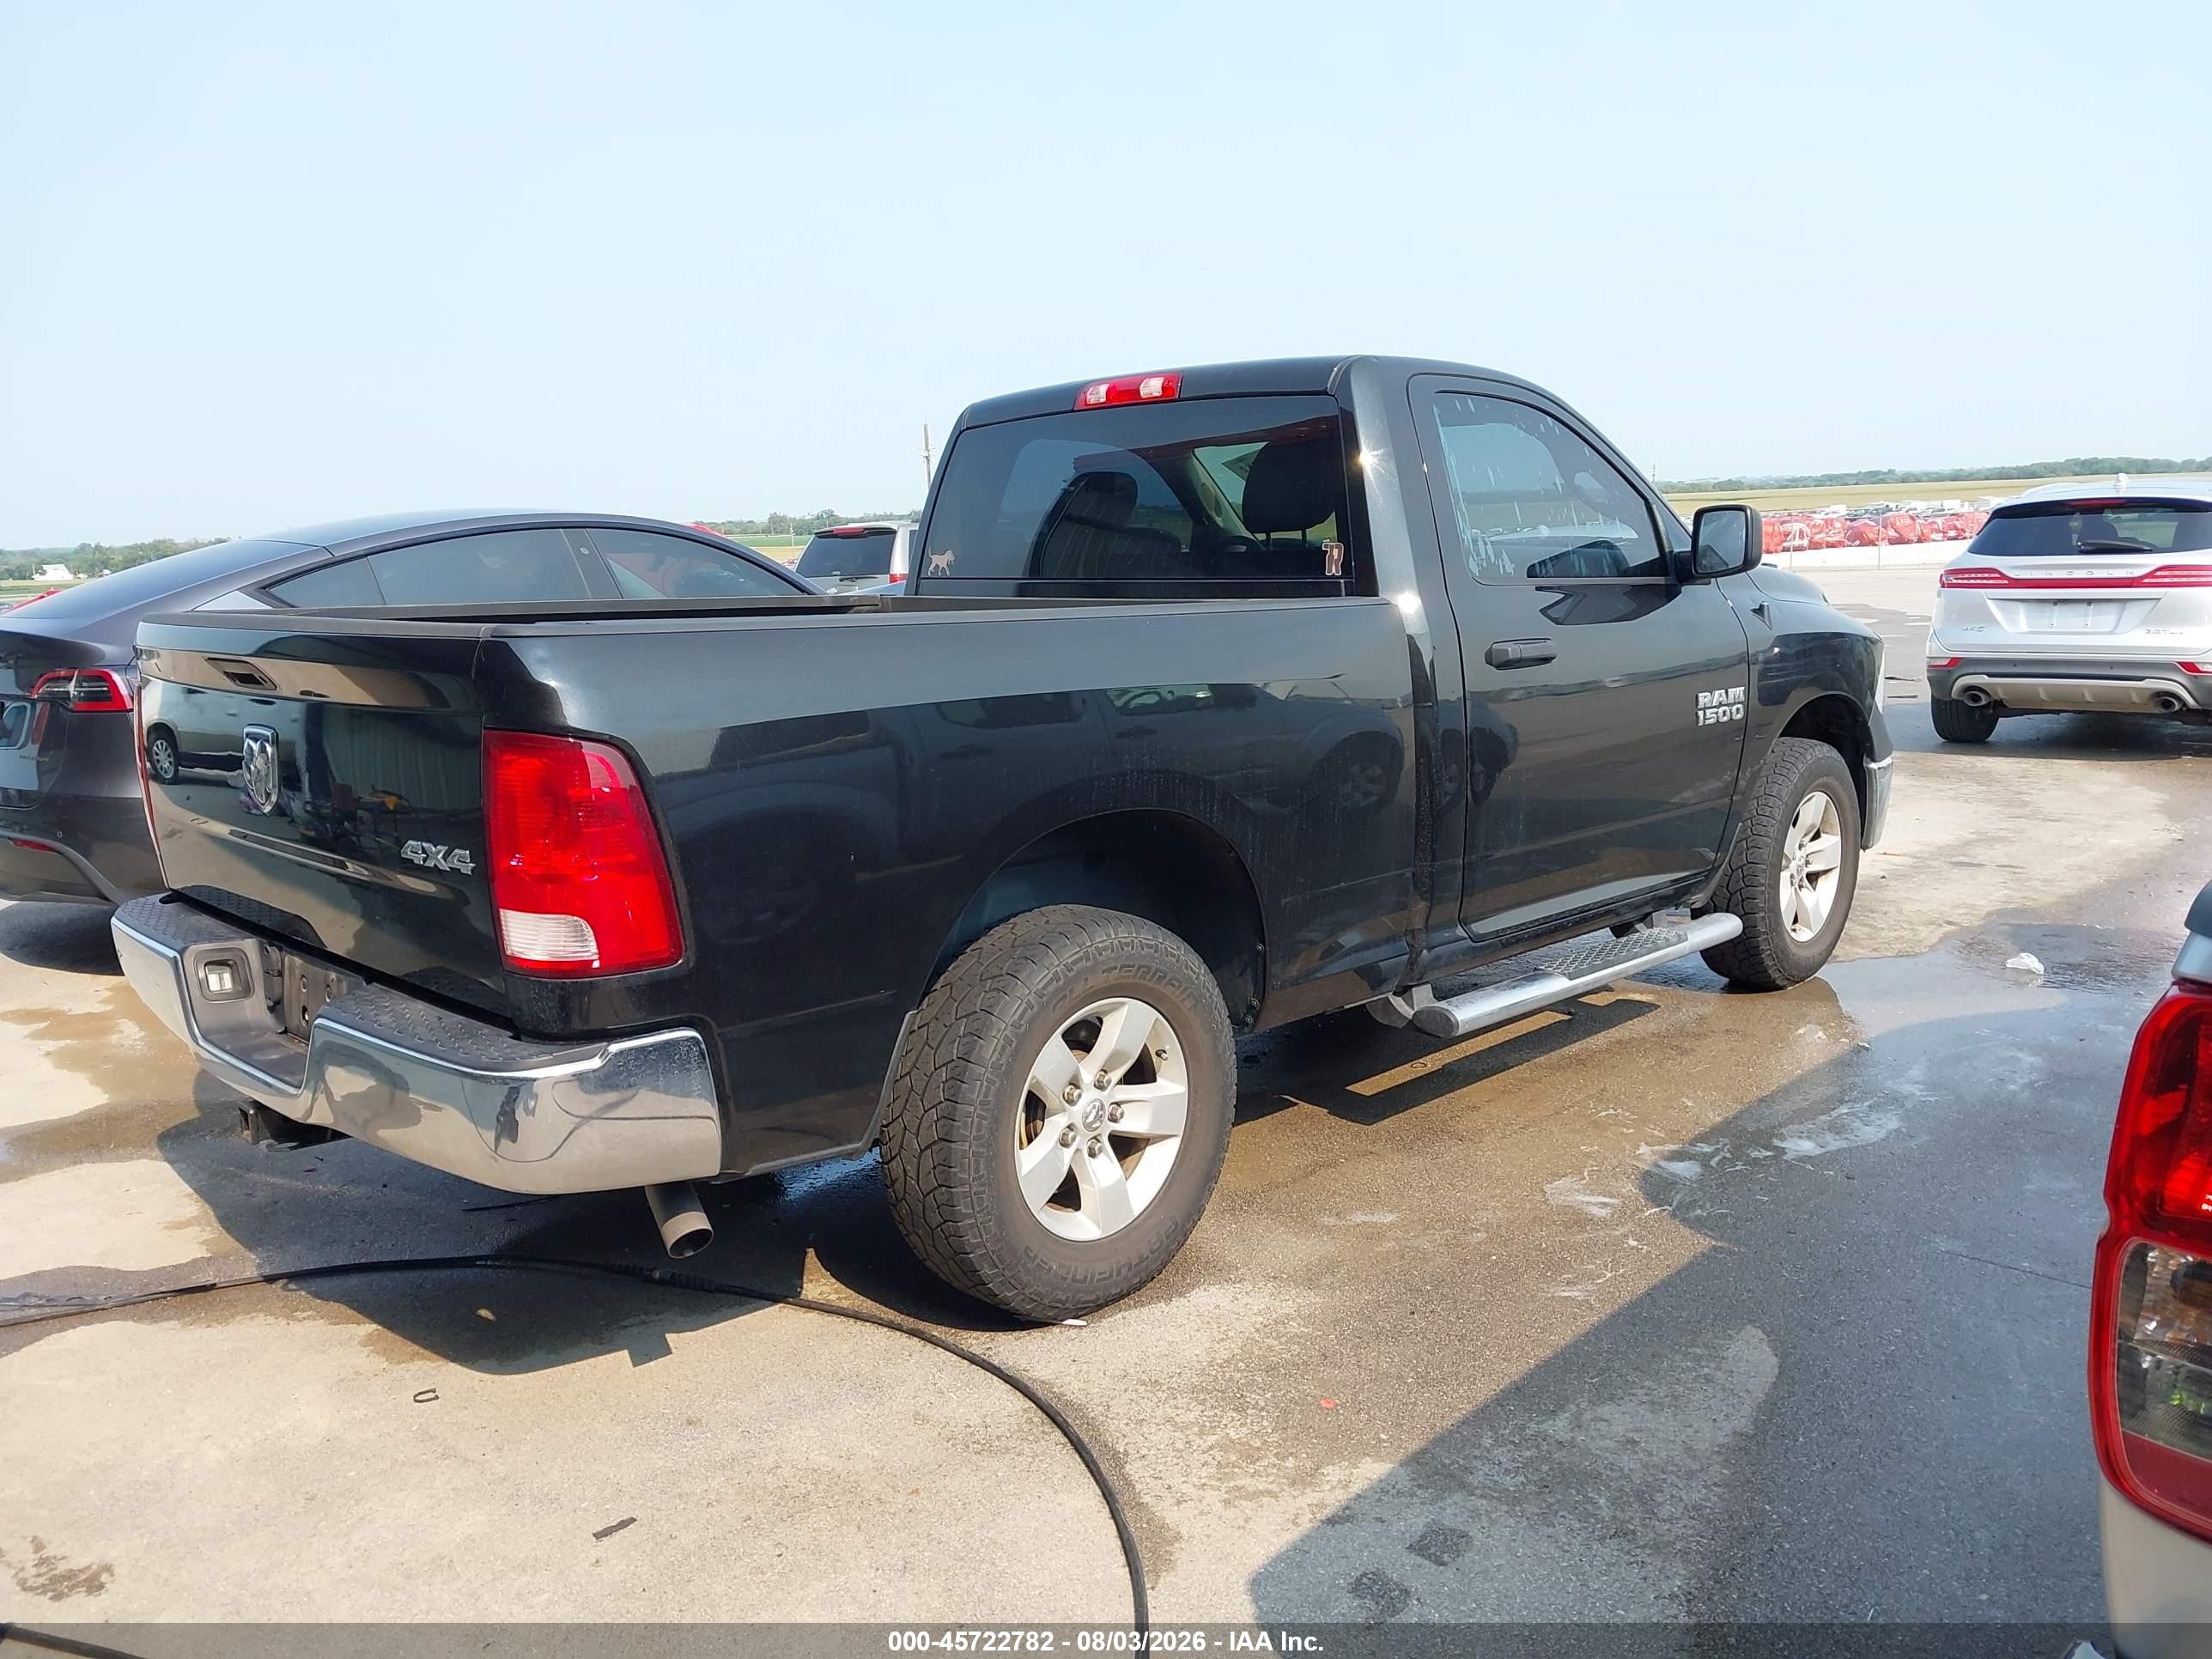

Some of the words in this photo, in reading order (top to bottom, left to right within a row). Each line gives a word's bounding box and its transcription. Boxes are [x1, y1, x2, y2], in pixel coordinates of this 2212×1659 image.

[1697, 686, 1745, 708] RAM
[1696, 704, 1744, 726] 1500
[1101, 963, 1200, 1010] TERRAIN
